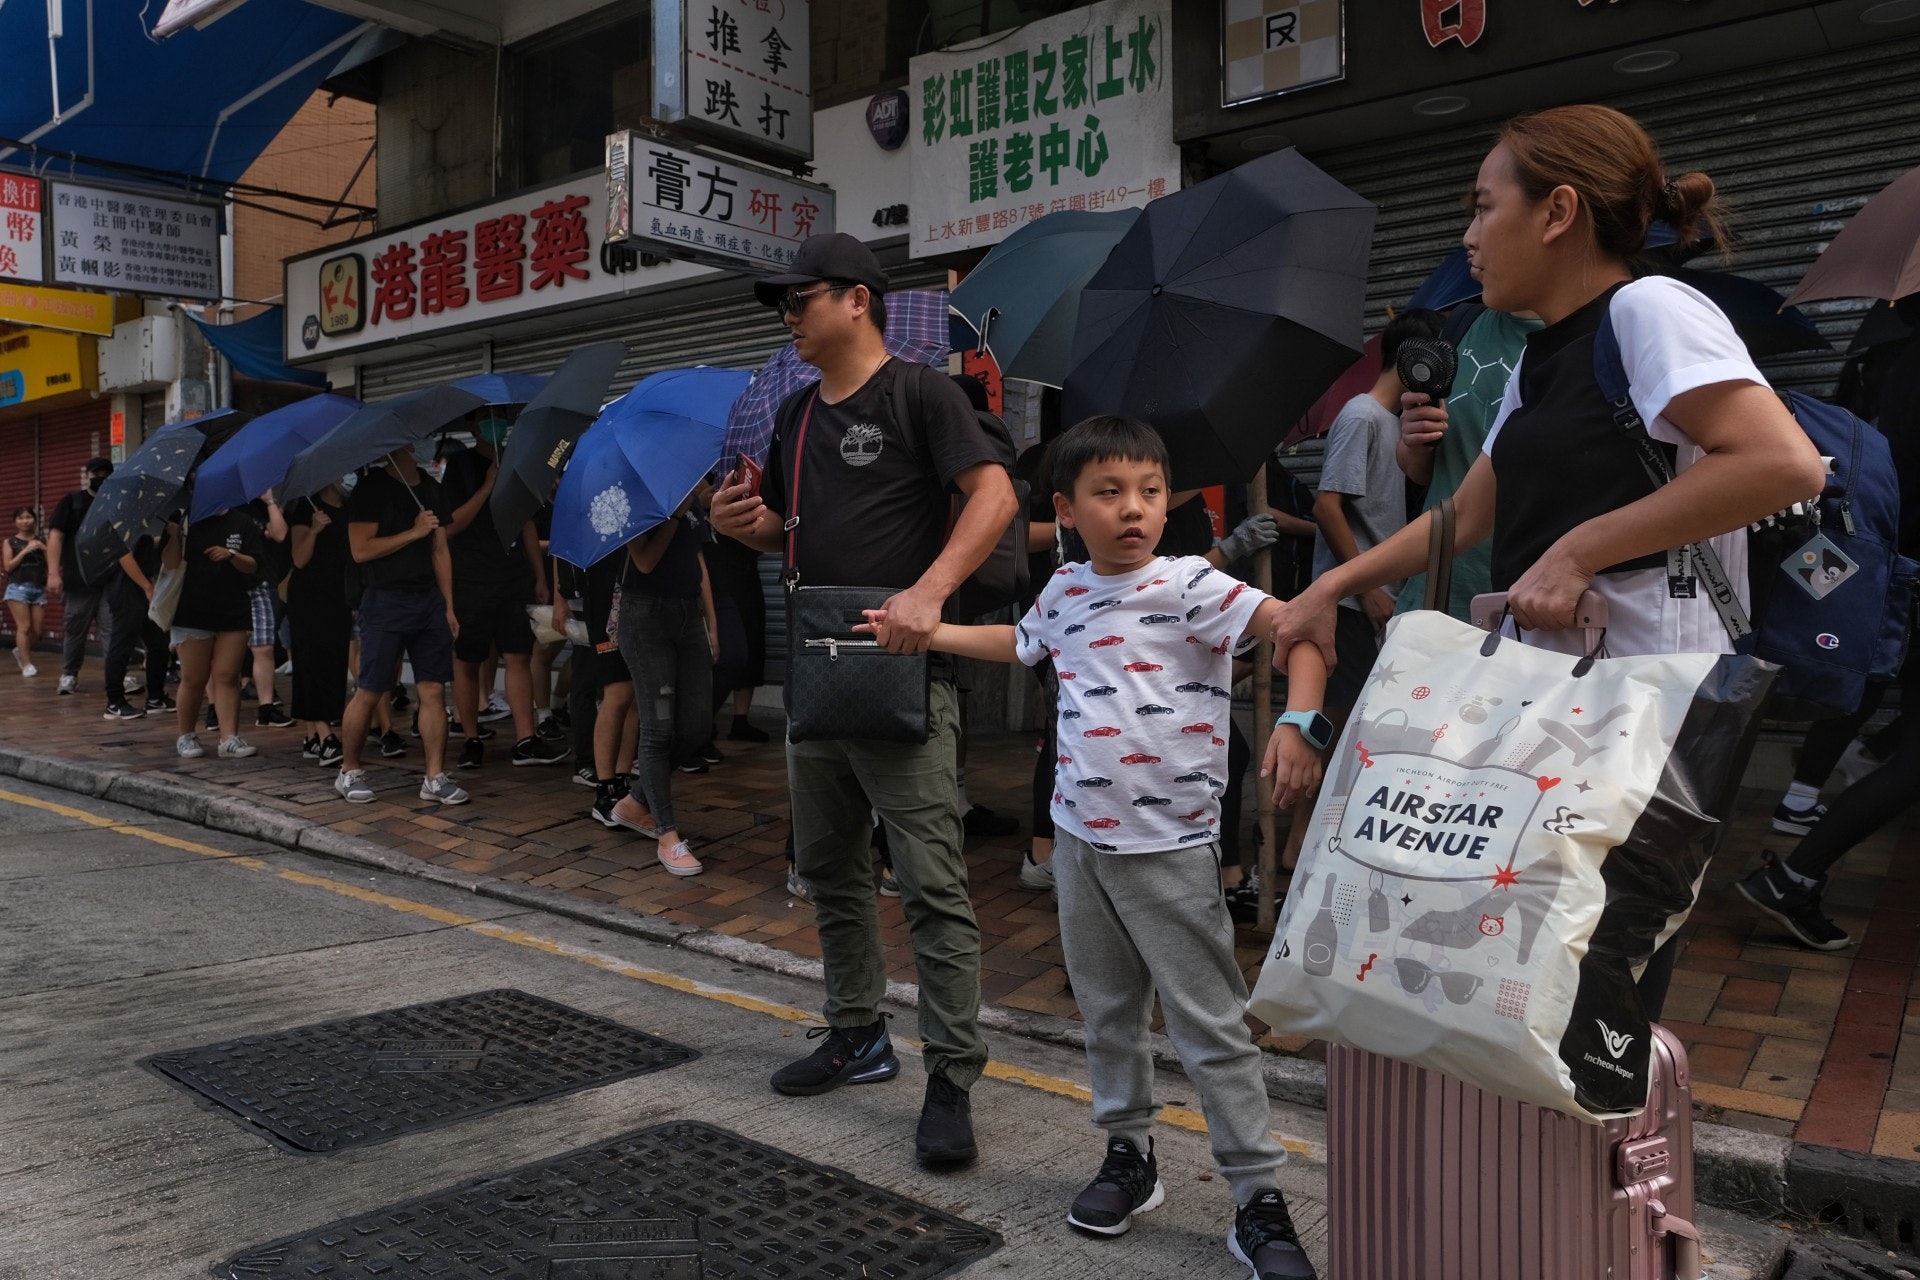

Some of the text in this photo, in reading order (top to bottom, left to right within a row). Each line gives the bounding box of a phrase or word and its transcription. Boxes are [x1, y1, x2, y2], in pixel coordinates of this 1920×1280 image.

[922, 12, 1163, 147] 彩虹護理之家(上水)
[704, 78, 791, 140] 跌打
[872, 99, 898, 121] ADT
[968, 113, 1110, 203] 護老中心
[57, 192, 213, 228] 香港中醫藥管理委員會
[93, 212, 182, 239] 註冊中醫師
[370, 194, 591, 326] 港龍醫藥
[330, 313, 349, 328] 1989
[546, 438, 571, 469] MARVEL
[1396, 767, 1435, 779] INCHEON
[1437, 775, 1470, 787] AIRPORT
[1490, 782, 1511, 792] FREE
[1364, 784, 1504, 829] AIRSTAR
[1353, 817, 1490, 861] AVENUE
[1583, 1052, 1634, 1081] Incheon Airport
